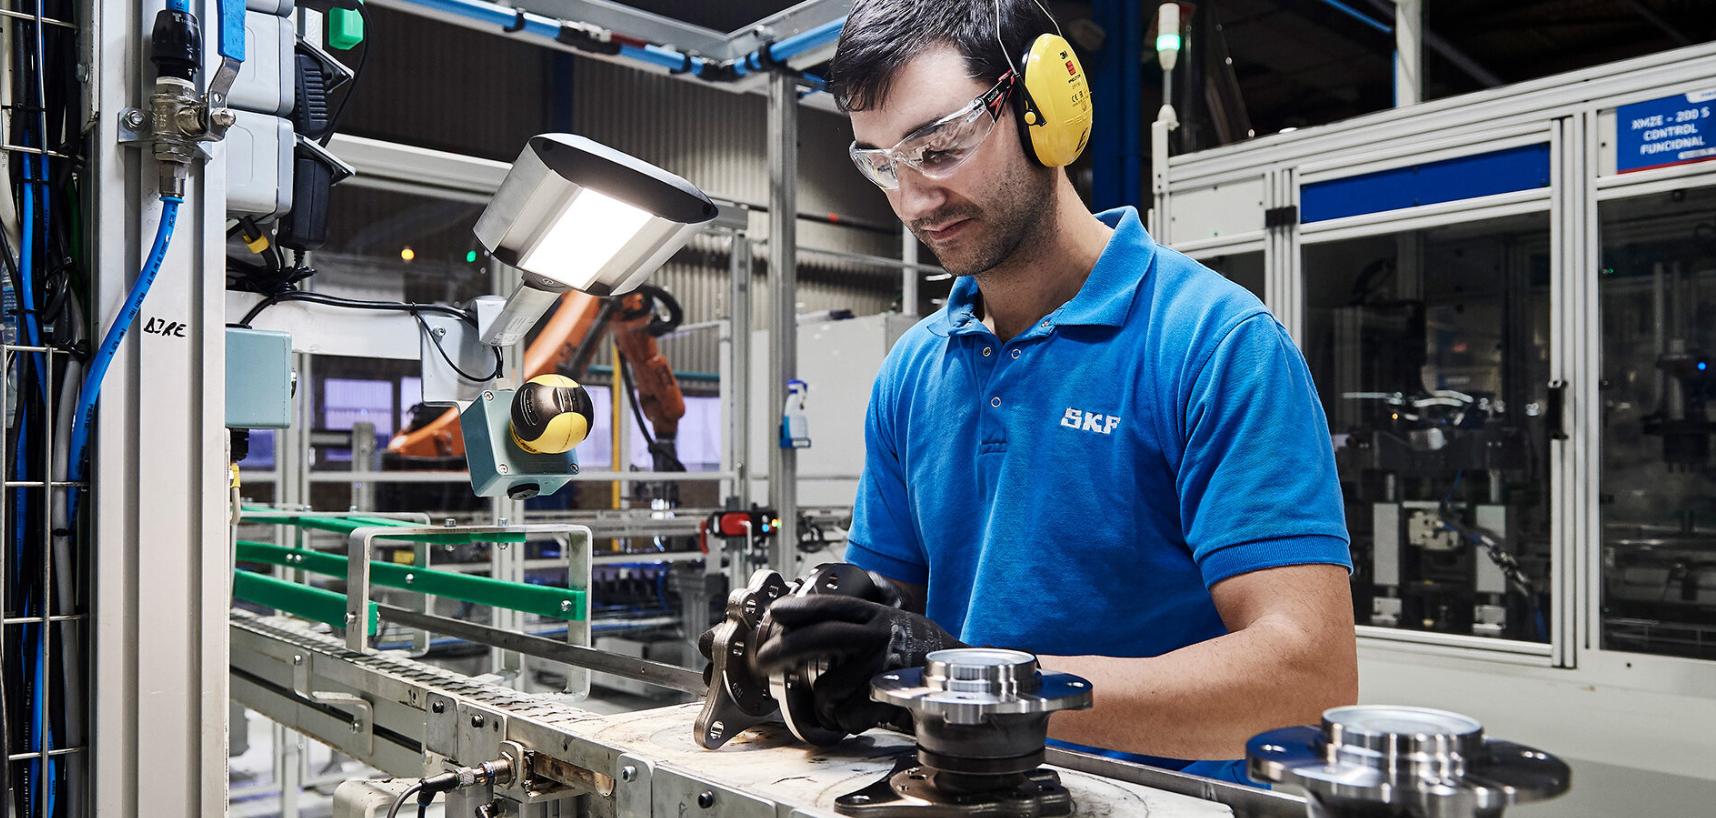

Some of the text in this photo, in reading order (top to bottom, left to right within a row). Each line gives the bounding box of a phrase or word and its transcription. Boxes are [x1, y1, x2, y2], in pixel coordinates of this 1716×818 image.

[1675, 108, 1699, 122] 200
[1643, 123, 1698, 141] CONTROL
[1640, 136, 1705, 155] FUNCIONAL
[1060, 406, 1121, 435] SKF
